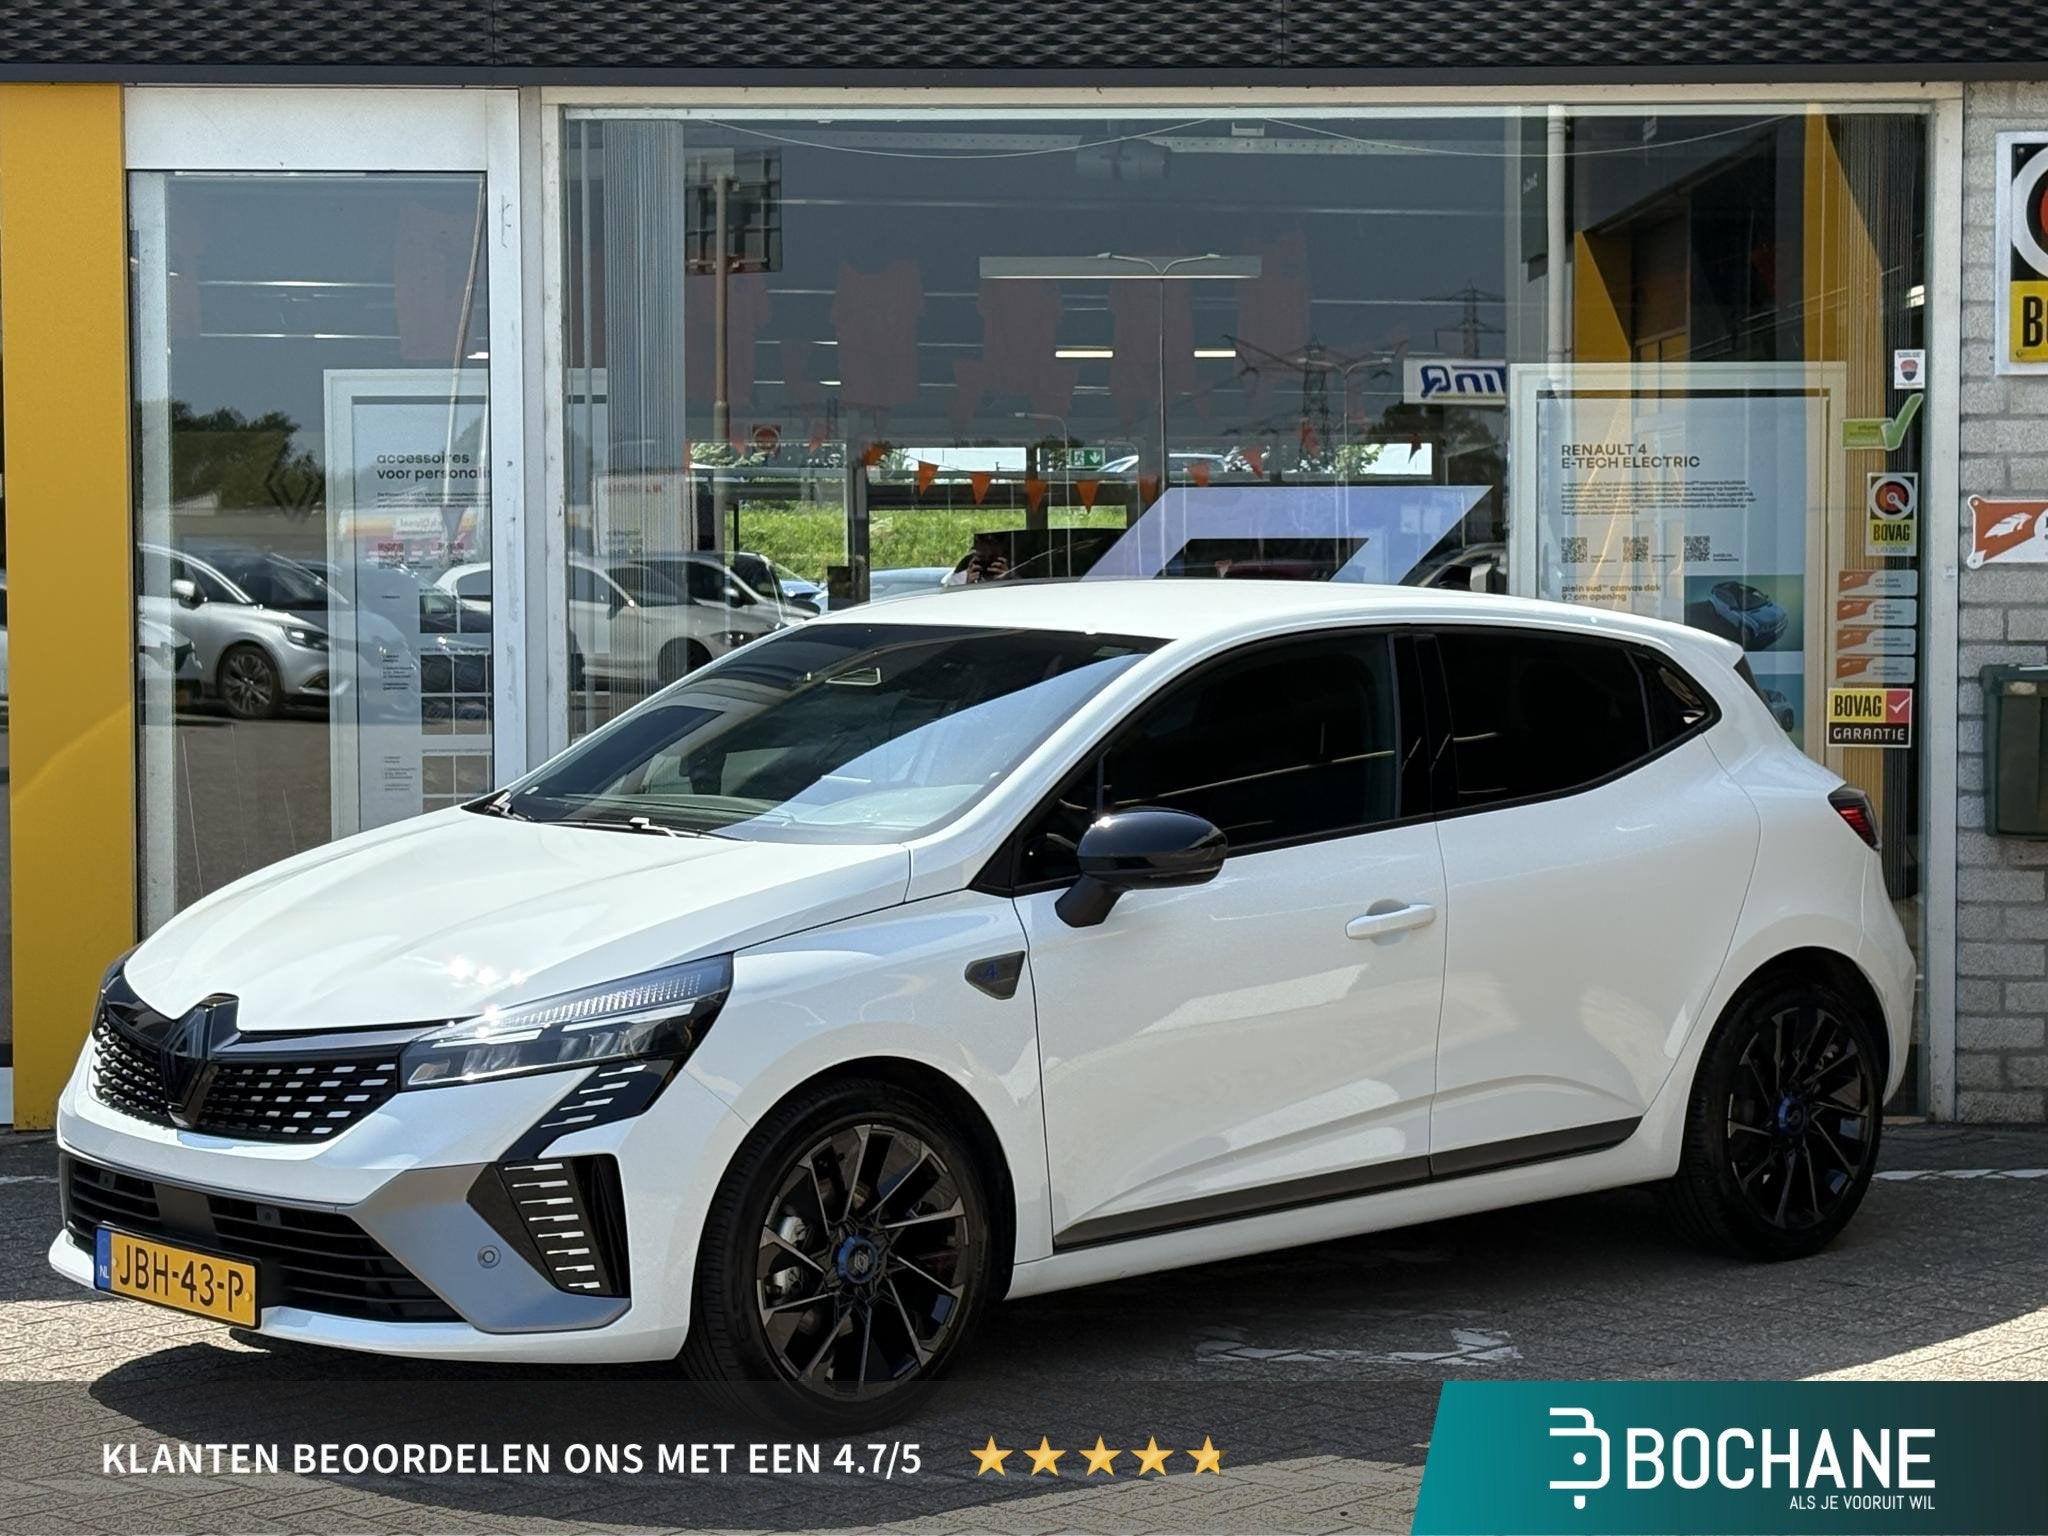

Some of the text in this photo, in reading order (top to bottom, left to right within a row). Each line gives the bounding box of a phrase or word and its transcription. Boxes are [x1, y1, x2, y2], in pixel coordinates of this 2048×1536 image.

[1561, 444, 1647, 456] RENAULT 4
[1561, 456, 1700, 469] E-TECH ELECTRIC
[377, 470, 411, 479] voor
[1873, 524, 1911, 541] BOVAG
[1834, 695, 1882, 717] BOVAG
[1833, 727, 1905, 740] GARANTIE
[99, 1264, 110, 1279] NL
[119, 1245, 244, 1312] JBH-43-P
